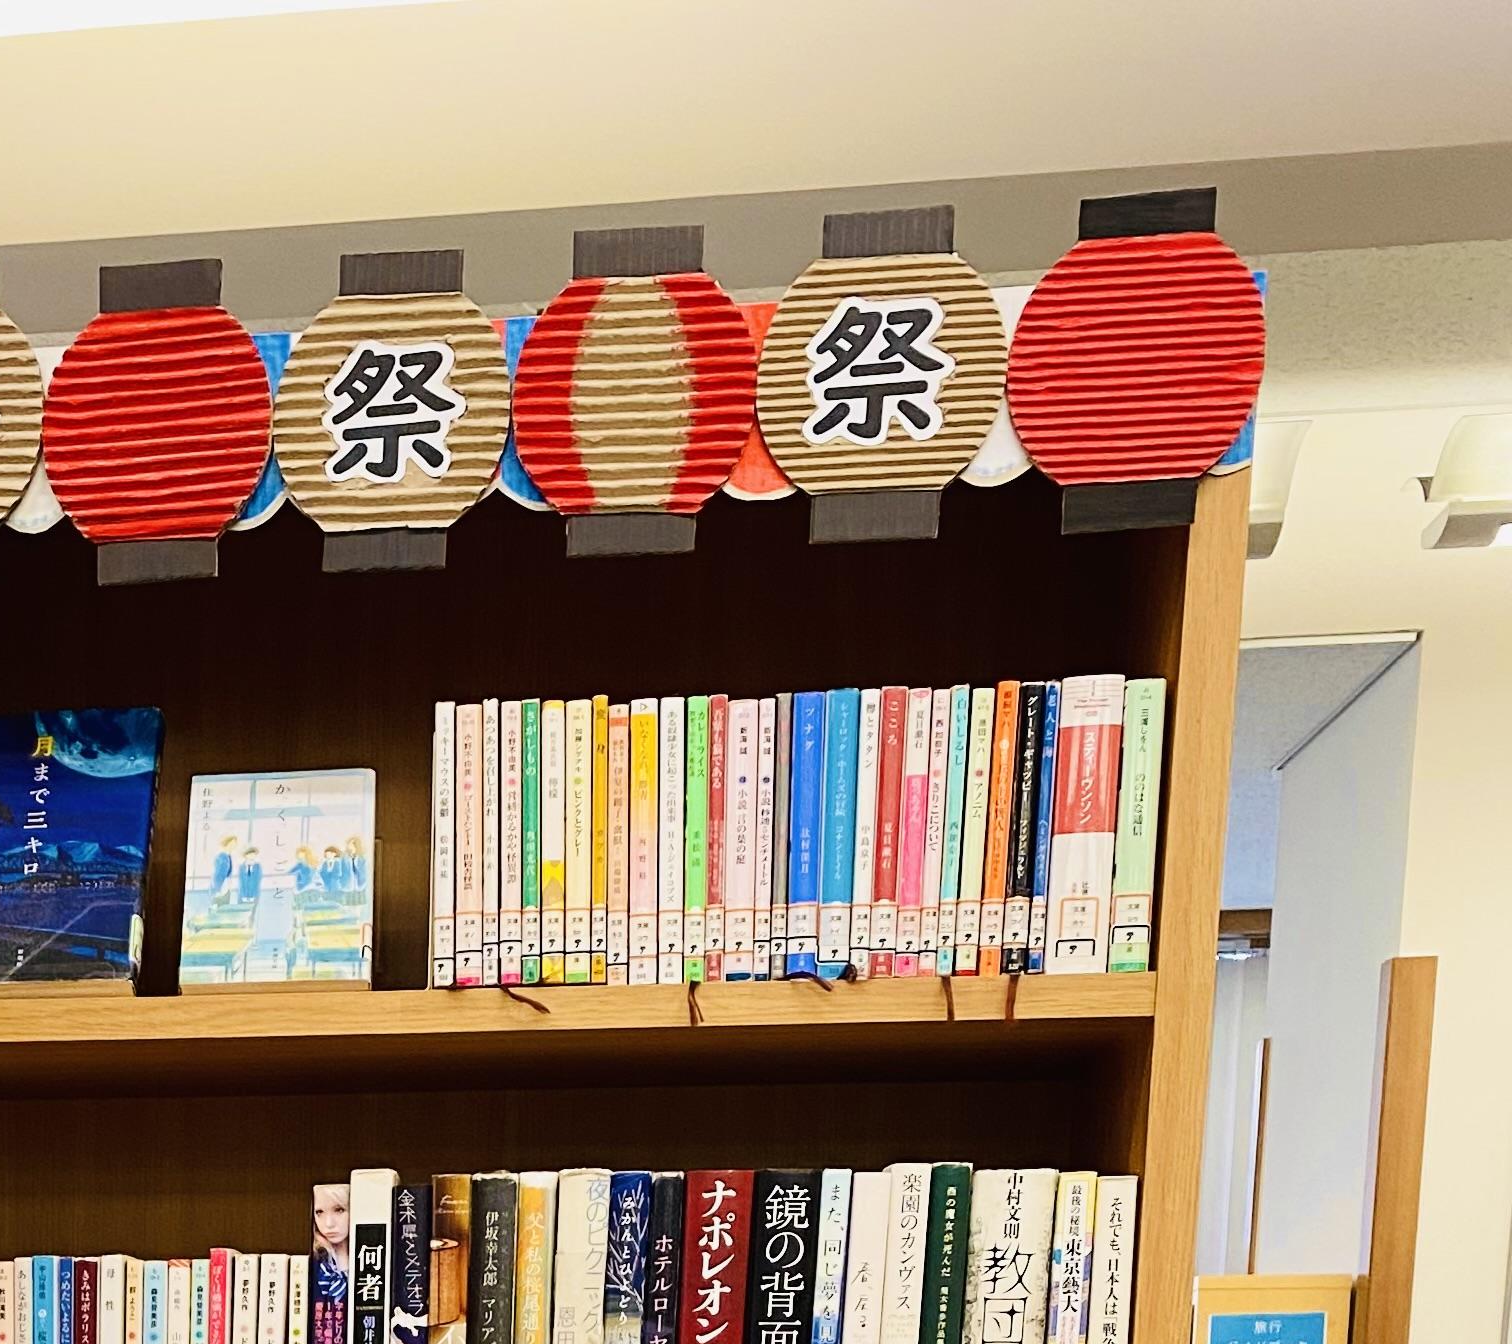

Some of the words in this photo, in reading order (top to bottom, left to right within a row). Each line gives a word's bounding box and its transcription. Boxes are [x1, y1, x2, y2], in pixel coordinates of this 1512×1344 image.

[813, 307, 945, 439] 祭
[332, 348, 454, 481] 祭
[524, 711, 538, 777] さがしもの
[803, 707, 816, 752] ツナグ
[887, 699, 901, 746] こころ
[23, 734, 55, 877] 月まで三キロ
[273, 783, 291, 899] かくしごと
[895, 1173, 923, 1311] 楽園のカンヴァス
[1002, 1171, 1025, 1241] 中村文則
[356, 1243, 384, 1302] 何者
[397, 1189, 424, 1317] 金木犀とメテオラ
[482, 1210, 500, 1288] 伊坂幸太郎
[582, 1176, 609, 1336] 夜のピクニック
[617, 1195, 637, 1326] みかんとひよどり
[1061, 1238, 1086, 1314] 東京藝大
[60, 1270, 71, 1344] つめたいよるに
[80, 1269, 91, 1344] きみはポラリス
[105, 1267, 116, 1312] 母性
[1254, 1320, 1283, 1335] 旅行
